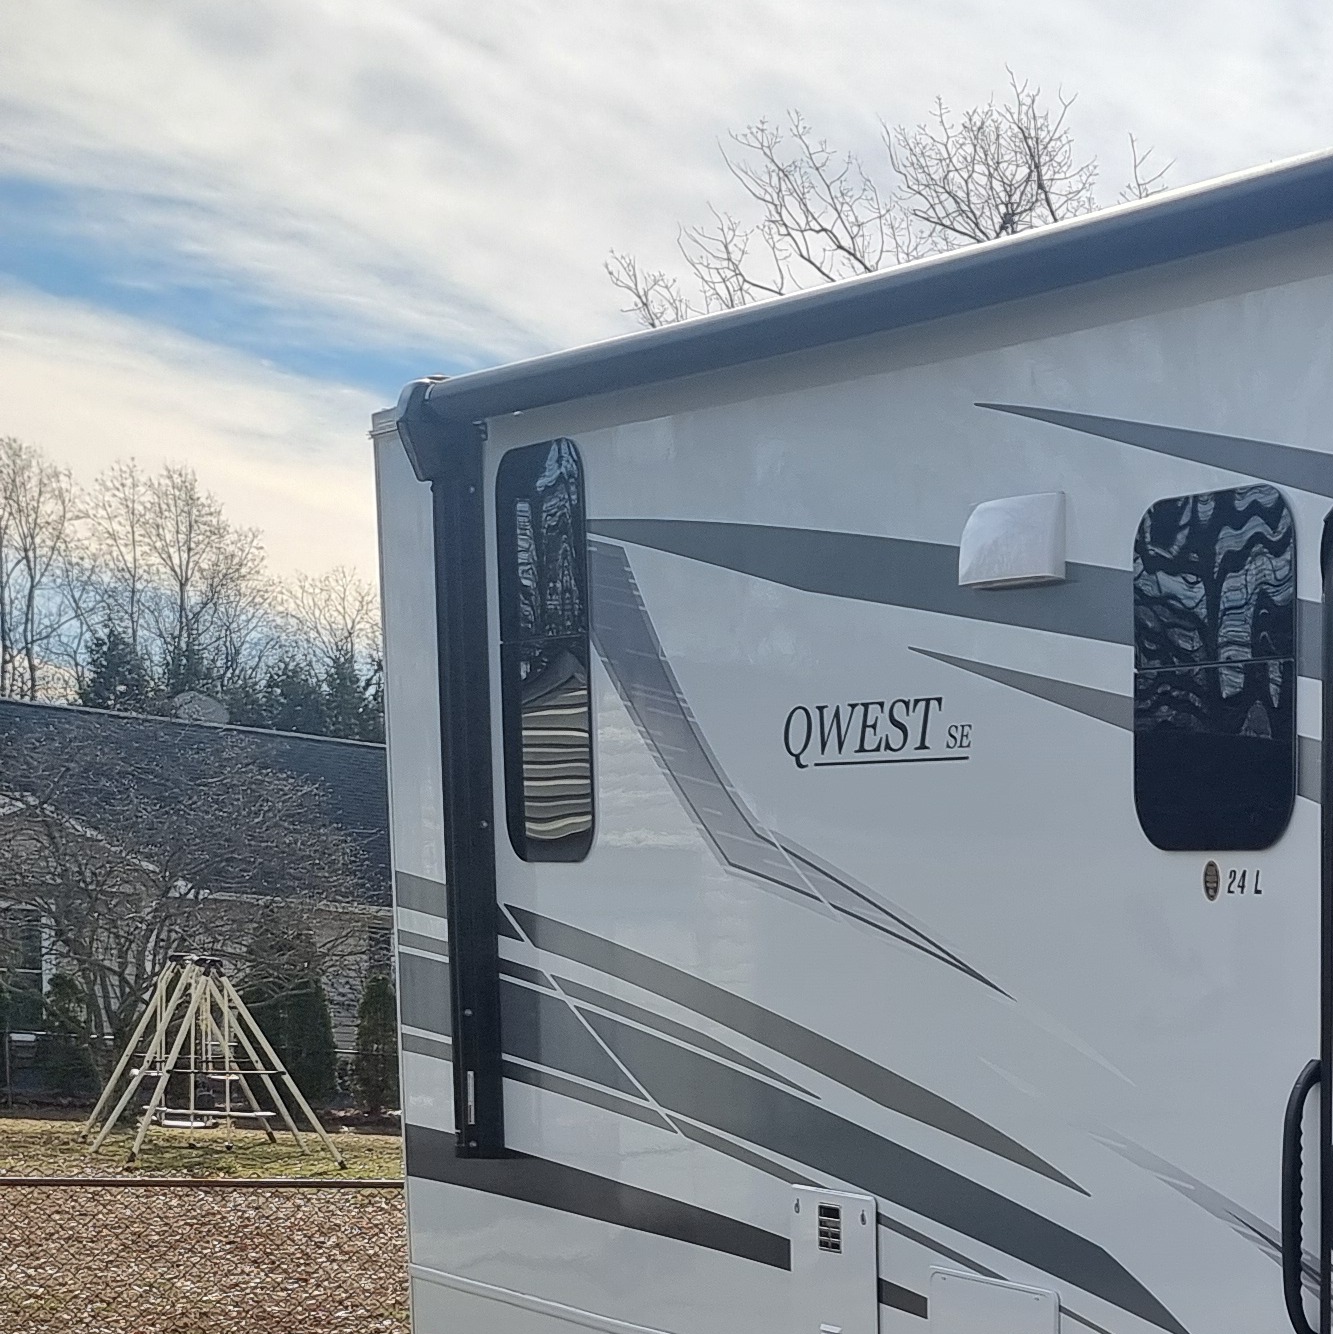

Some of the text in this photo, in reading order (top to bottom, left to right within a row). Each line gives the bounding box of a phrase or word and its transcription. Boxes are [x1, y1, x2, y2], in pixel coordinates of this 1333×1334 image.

[784, 696, 973, 769] QWEST SE
[1226, 869, 1263, 895] 24 L
